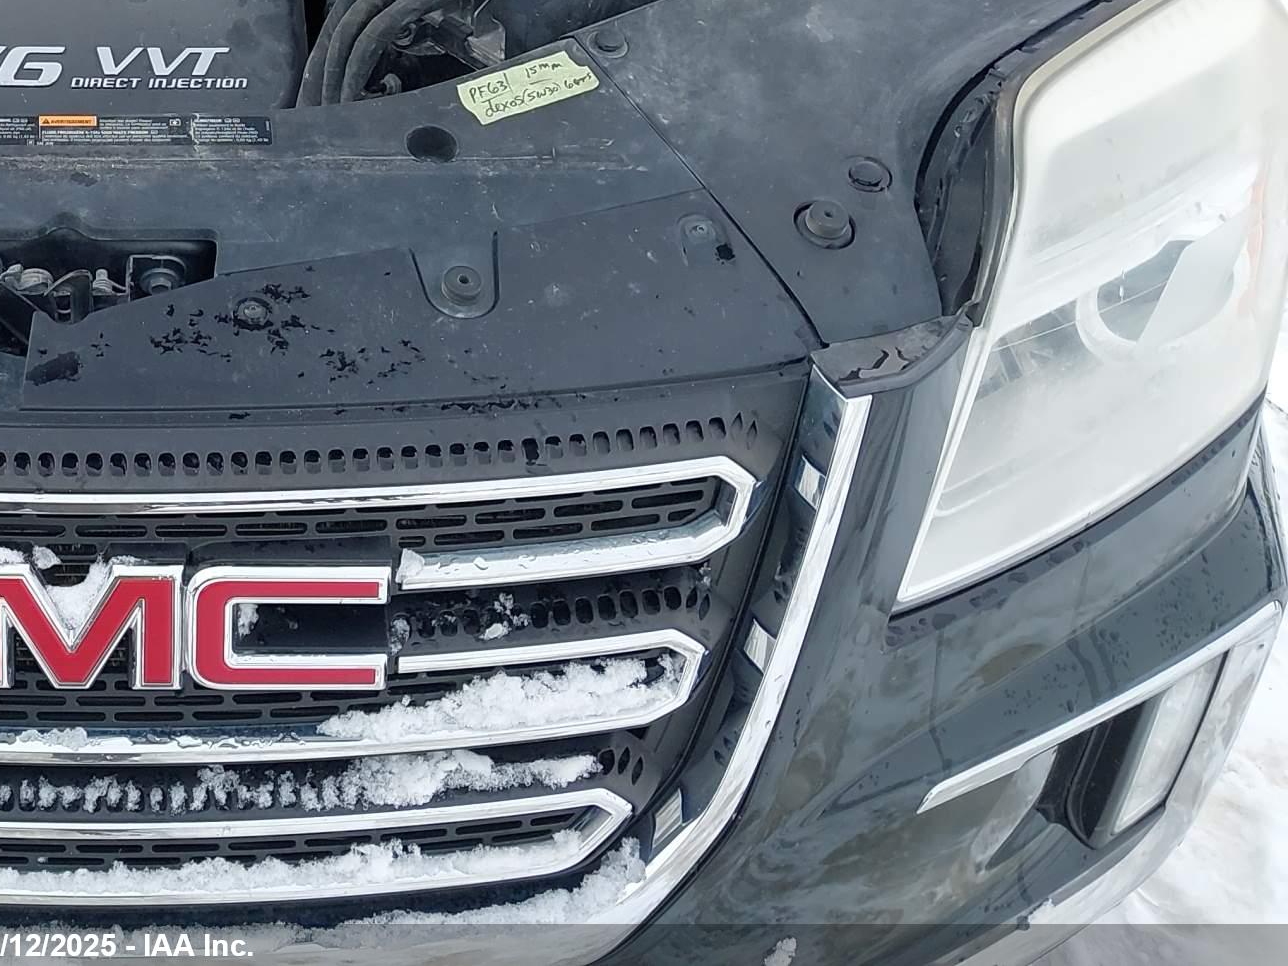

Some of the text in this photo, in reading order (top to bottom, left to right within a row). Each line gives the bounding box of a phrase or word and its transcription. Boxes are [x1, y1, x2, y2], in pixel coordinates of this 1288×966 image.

[96, 46, 231, 76] VVT
[70, 77, 248, 89] DIRECT INJECTION
[469, 79, 508, 104] PF63
